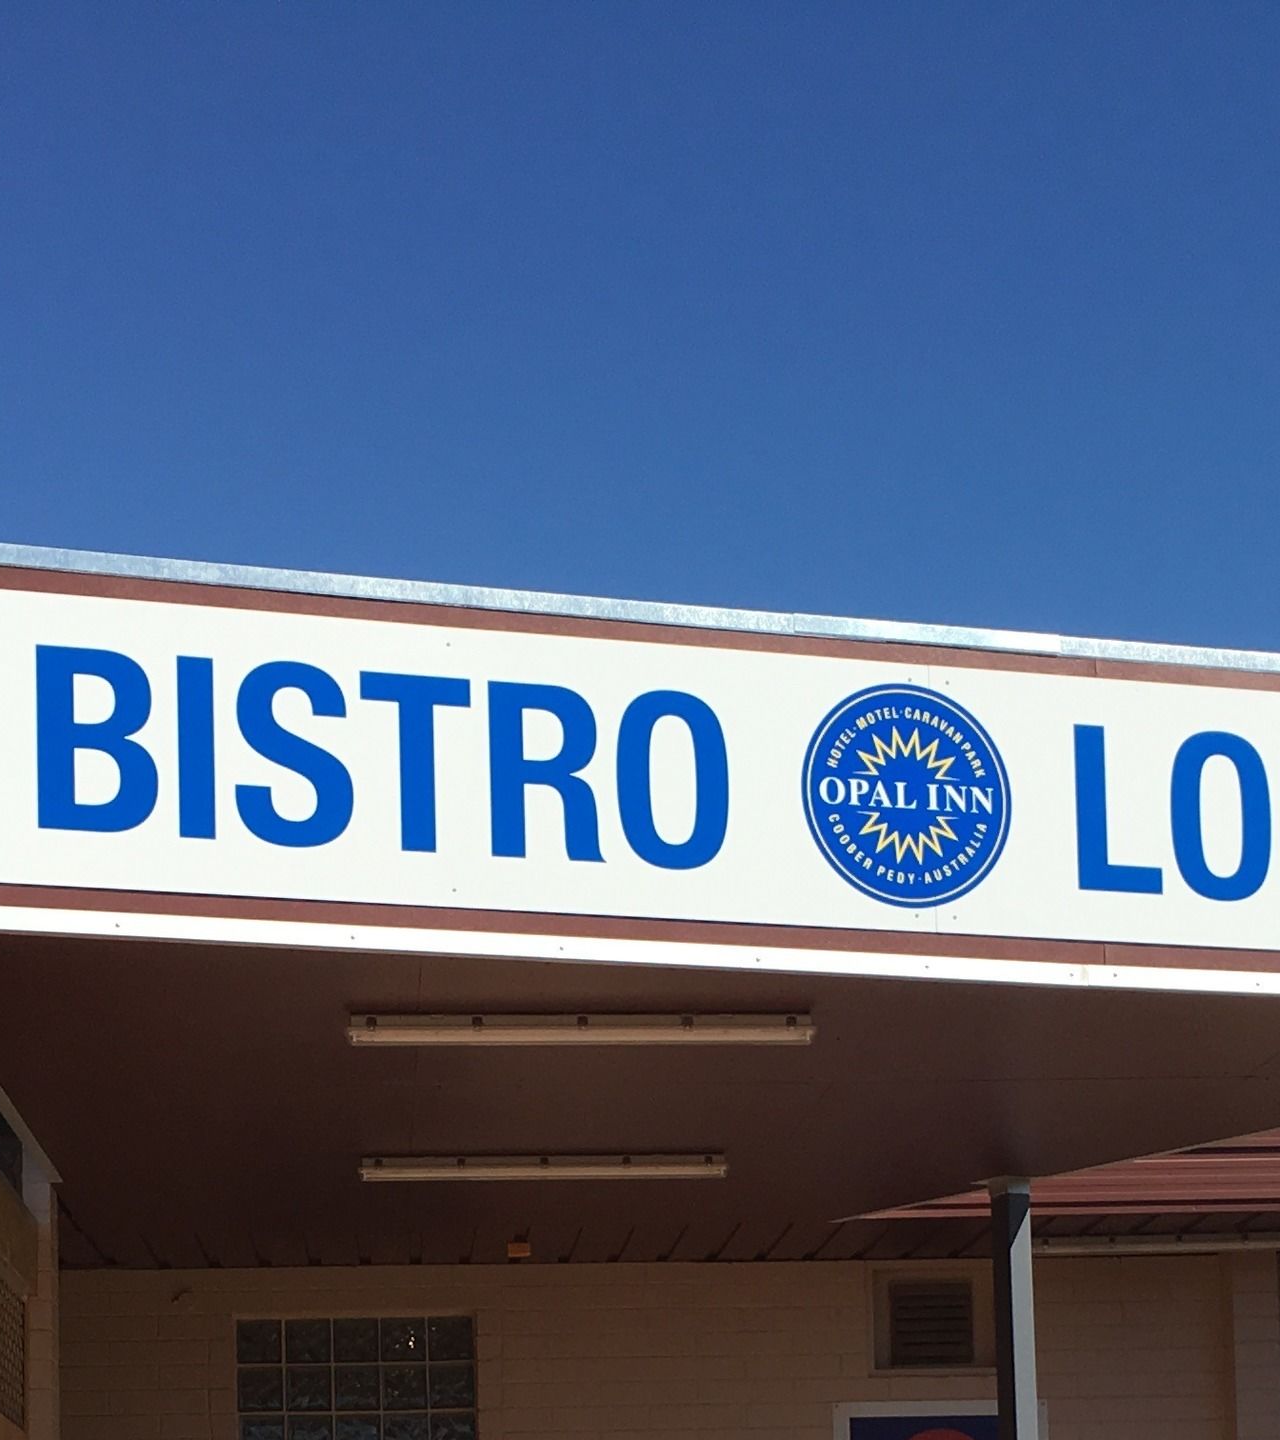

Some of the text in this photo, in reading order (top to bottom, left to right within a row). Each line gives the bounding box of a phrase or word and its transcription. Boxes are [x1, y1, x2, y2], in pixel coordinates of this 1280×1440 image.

[35, 644, 730, 870] BISTRO
[827, 706, 986, 779] HOTEL MOTEL CARAVAN PARK
[819, 776, 994, 815] OPAL INN
[828, 814, 988, 884] COOBER PEDY AUSTRALIA
